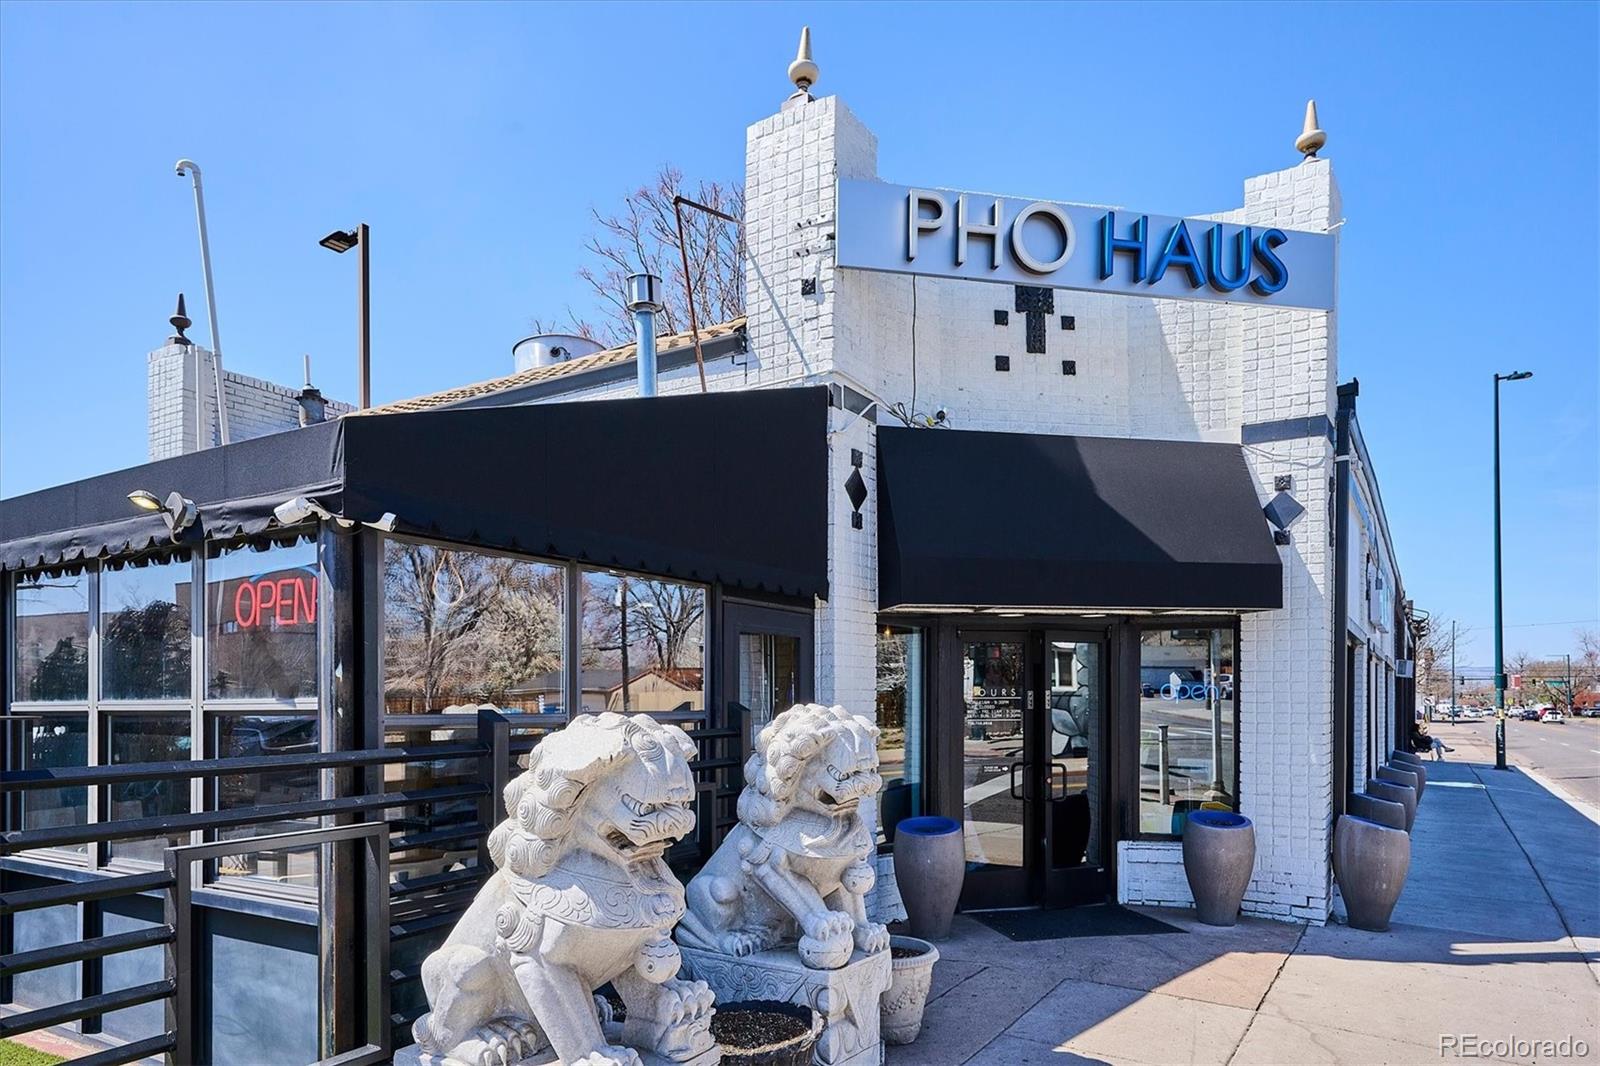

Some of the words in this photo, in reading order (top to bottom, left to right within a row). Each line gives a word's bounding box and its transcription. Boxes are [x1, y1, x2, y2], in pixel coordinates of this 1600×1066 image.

[905, 188, 1076, 275] PHO
[1099, 211, 1289, 297] HAUS
[234, 577, 317, 627] OPEN
[968, 688, 1016, 697] OURS
[1160, 683, 1219, 704] open
